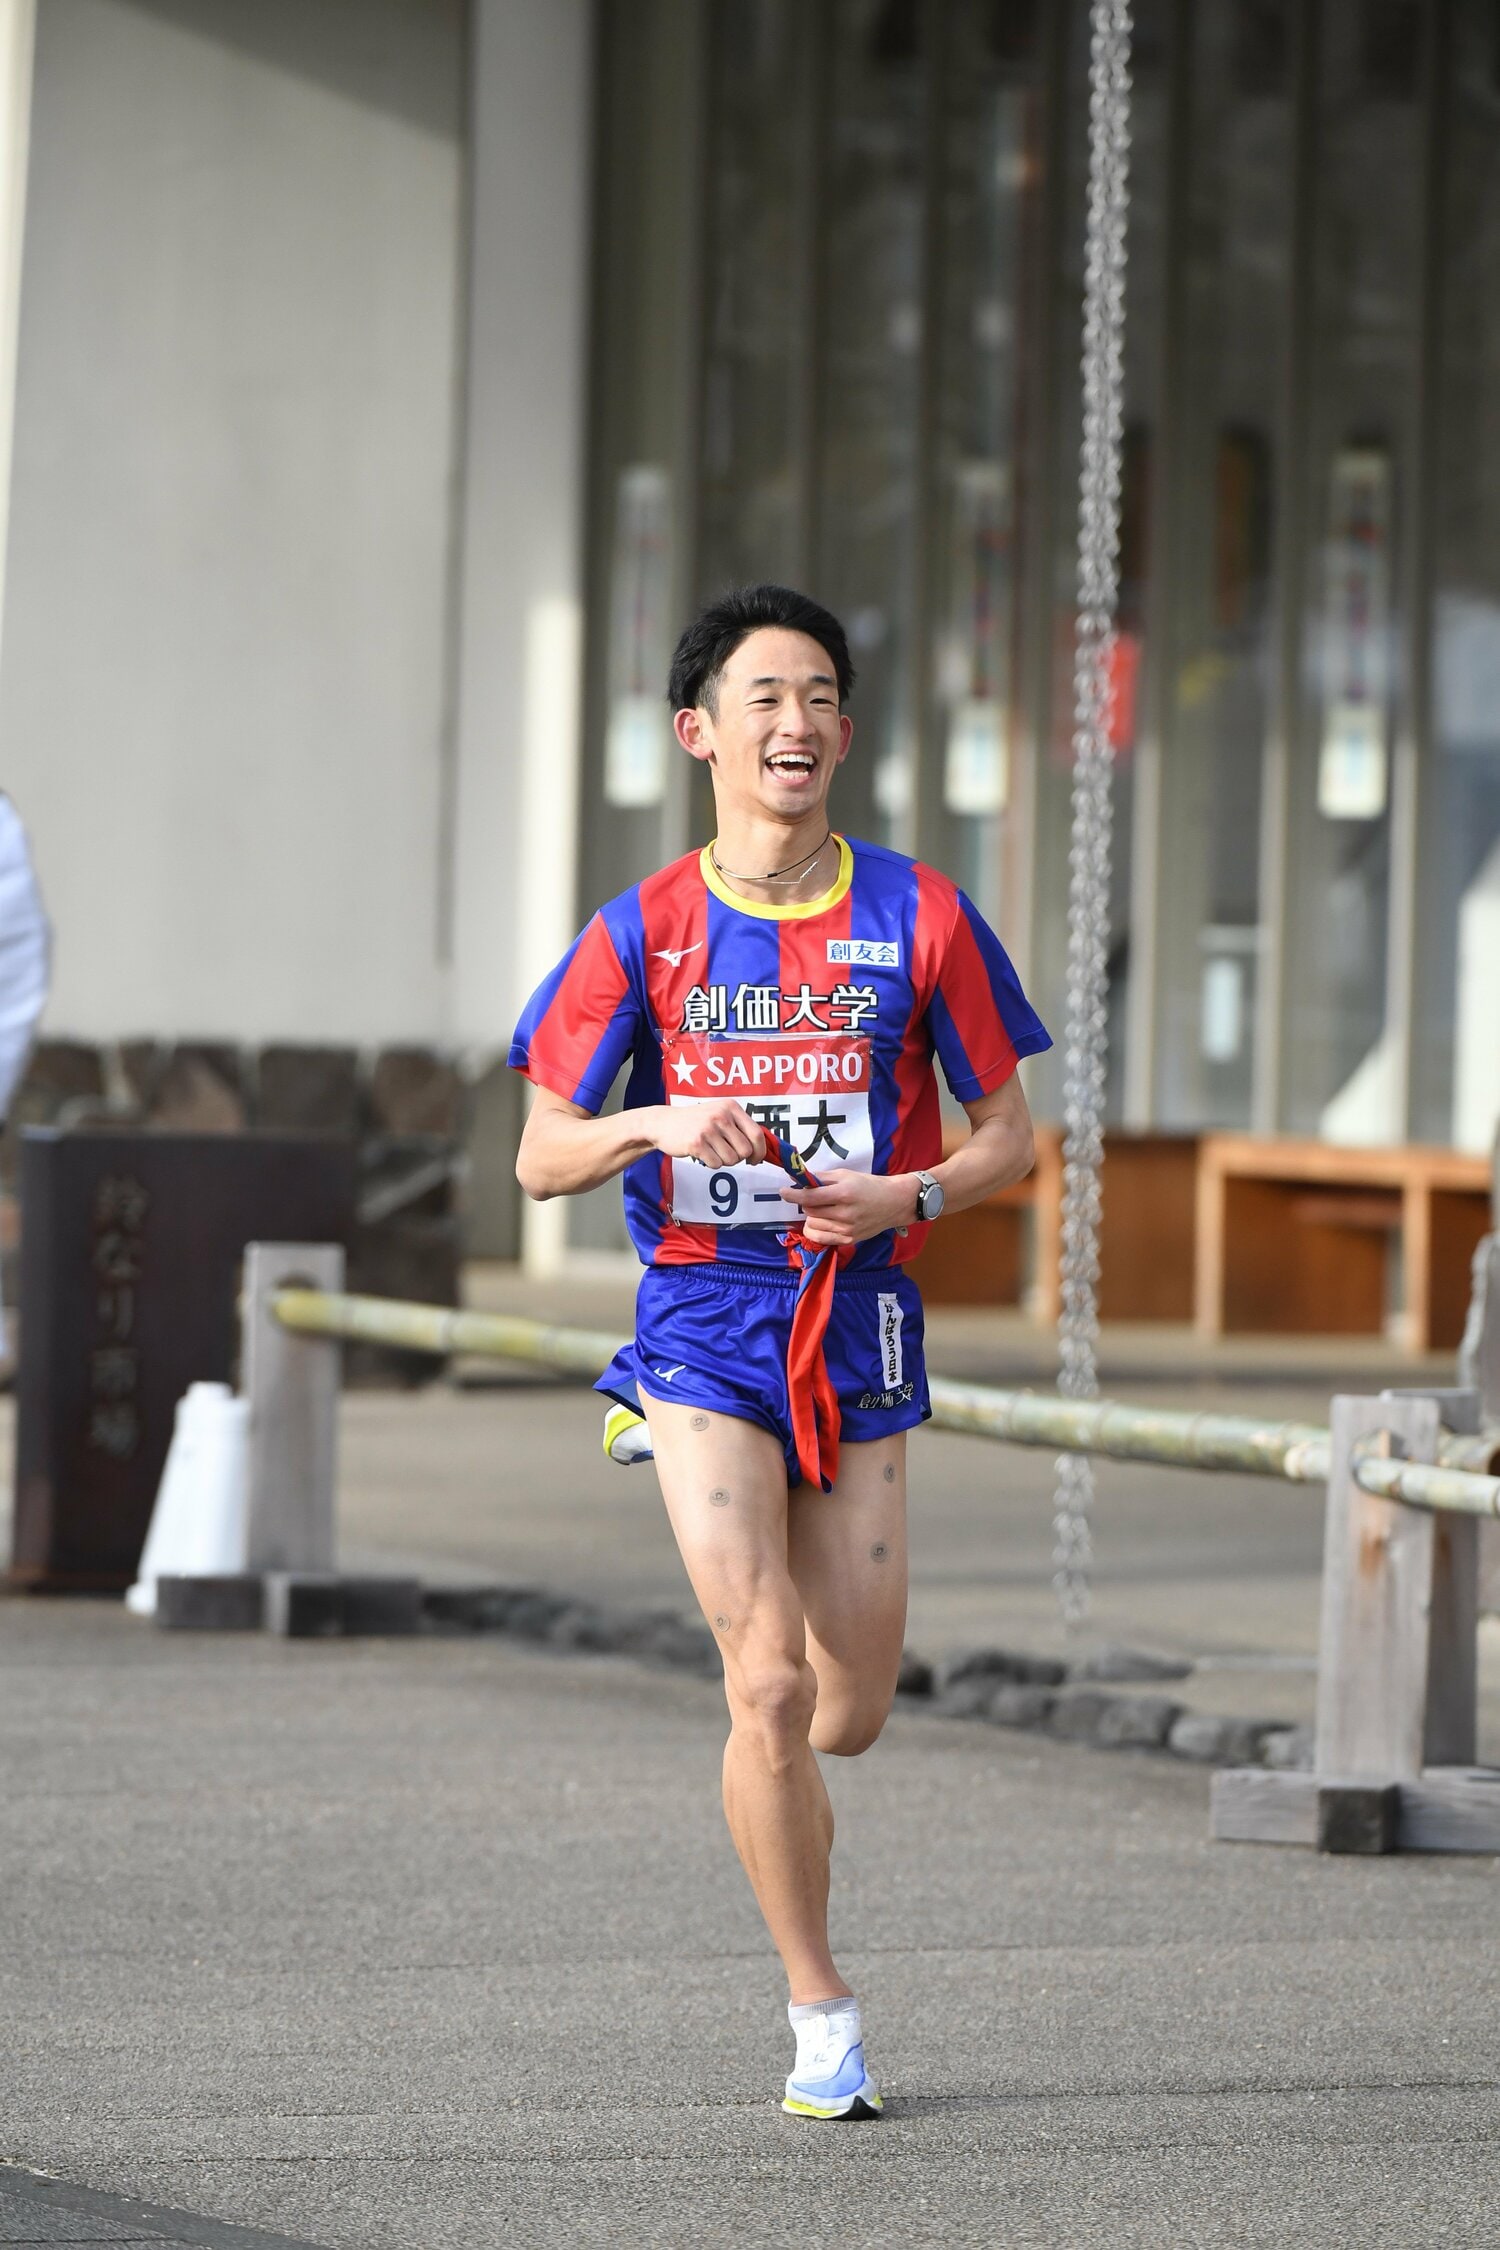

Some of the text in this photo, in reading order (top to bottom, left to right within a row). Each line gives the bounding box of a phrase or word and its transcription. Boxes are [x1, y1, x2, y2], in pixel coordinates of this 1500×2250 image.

[830, 943, 895, 963] 創友会
[681, 983, 879, 1032] 創価大学
[706, 1052, 862, 1086] SAPPORO
